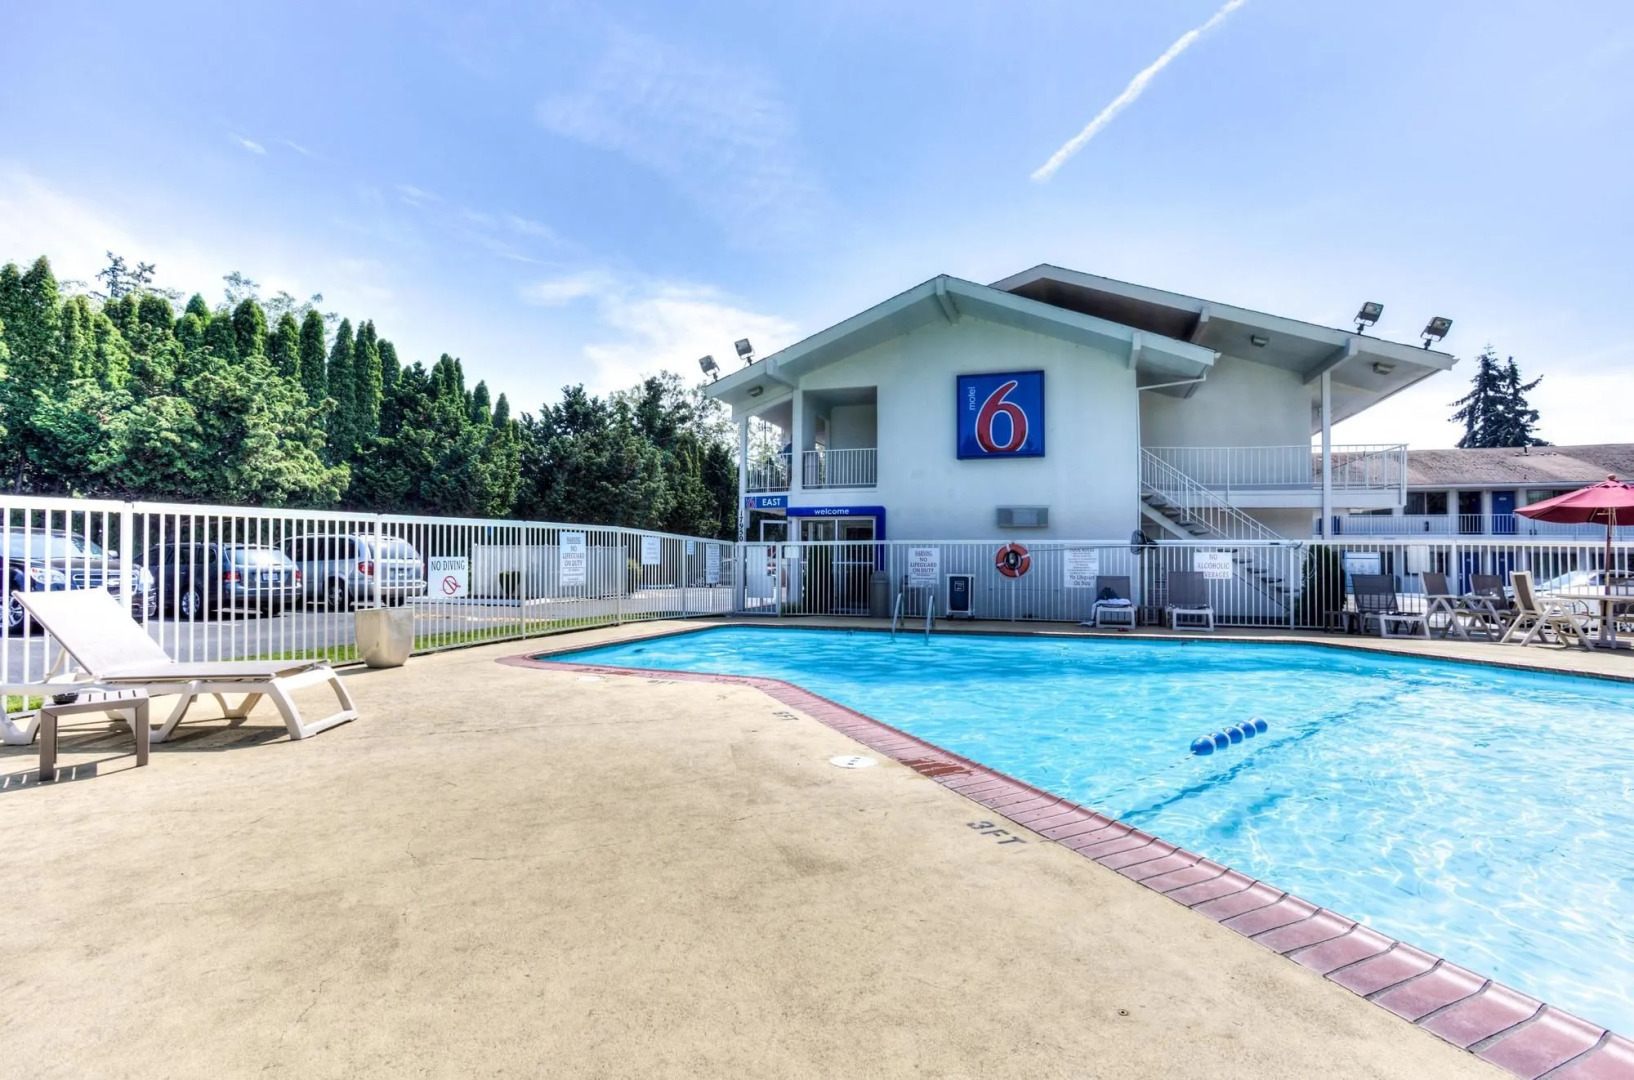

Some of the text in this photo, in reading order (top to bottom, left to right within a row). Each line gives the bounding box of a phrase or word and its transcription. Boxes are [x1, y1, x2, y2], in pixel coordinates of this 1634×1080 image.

[968, 386, 976, 411] motel
[974, 379, 1029, 453] 6
[762, 497, 782, 506] EAST
[1208, 553, 1218, 561] NO
[431, 560, 465, 571] NO DIVING
[1197, 562, 1230, 570] ALCOHOLIC
[966, 820, 1027, 844] 3FT
